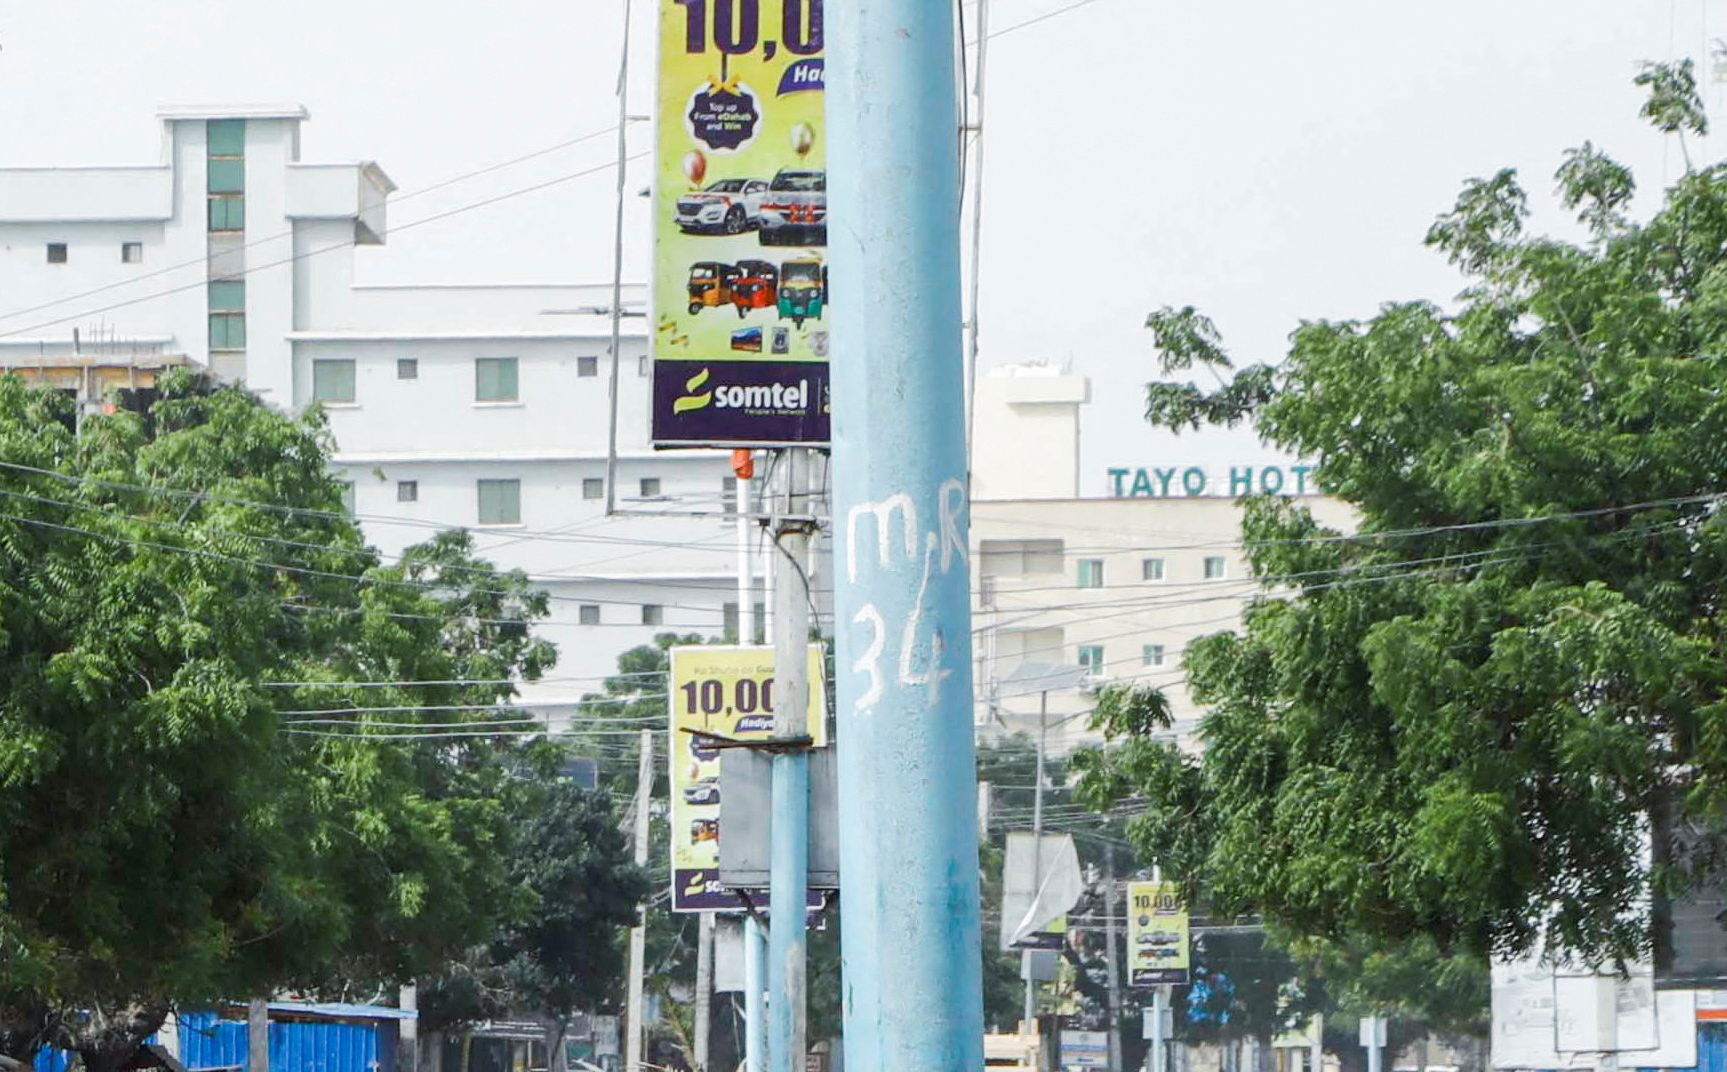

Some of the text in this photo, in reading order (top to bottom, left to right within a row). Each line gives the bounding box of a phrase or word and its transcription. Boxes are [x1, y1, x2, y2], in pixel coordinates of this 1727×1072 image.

[793, 65, 824, 83] Ha
[714, 379, 808, 409] somtel
[1108, 466, 1206, 497] TAYO
[852, 603, 953, 717] 34
[680, 678, 775, 717] 10,00
